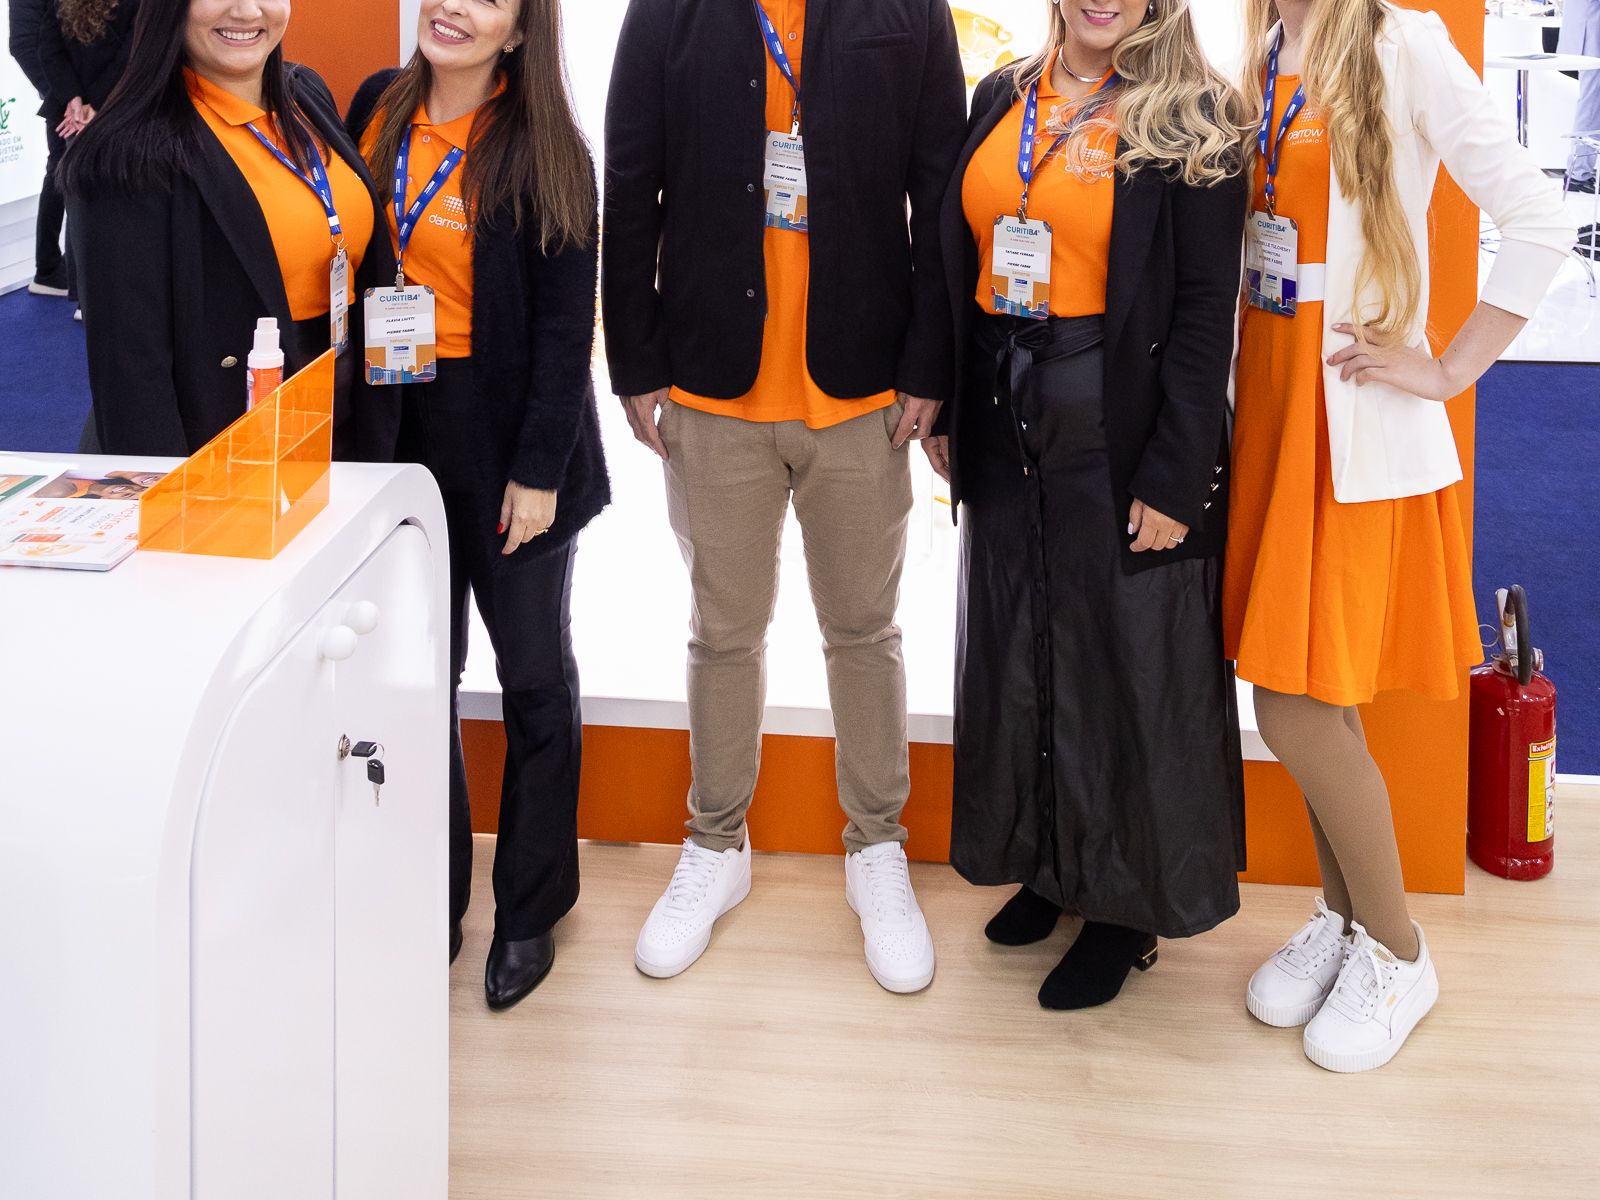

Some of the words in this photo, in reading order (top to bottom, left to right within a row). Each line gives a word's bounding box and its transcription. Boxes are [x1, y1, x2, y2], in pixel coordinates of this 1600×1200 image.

[772, 140, 804, 152] CURITIB
[1006, 225, 1038, 236] CURITIBA
[379, 294, 418, 303] CURITIBA
